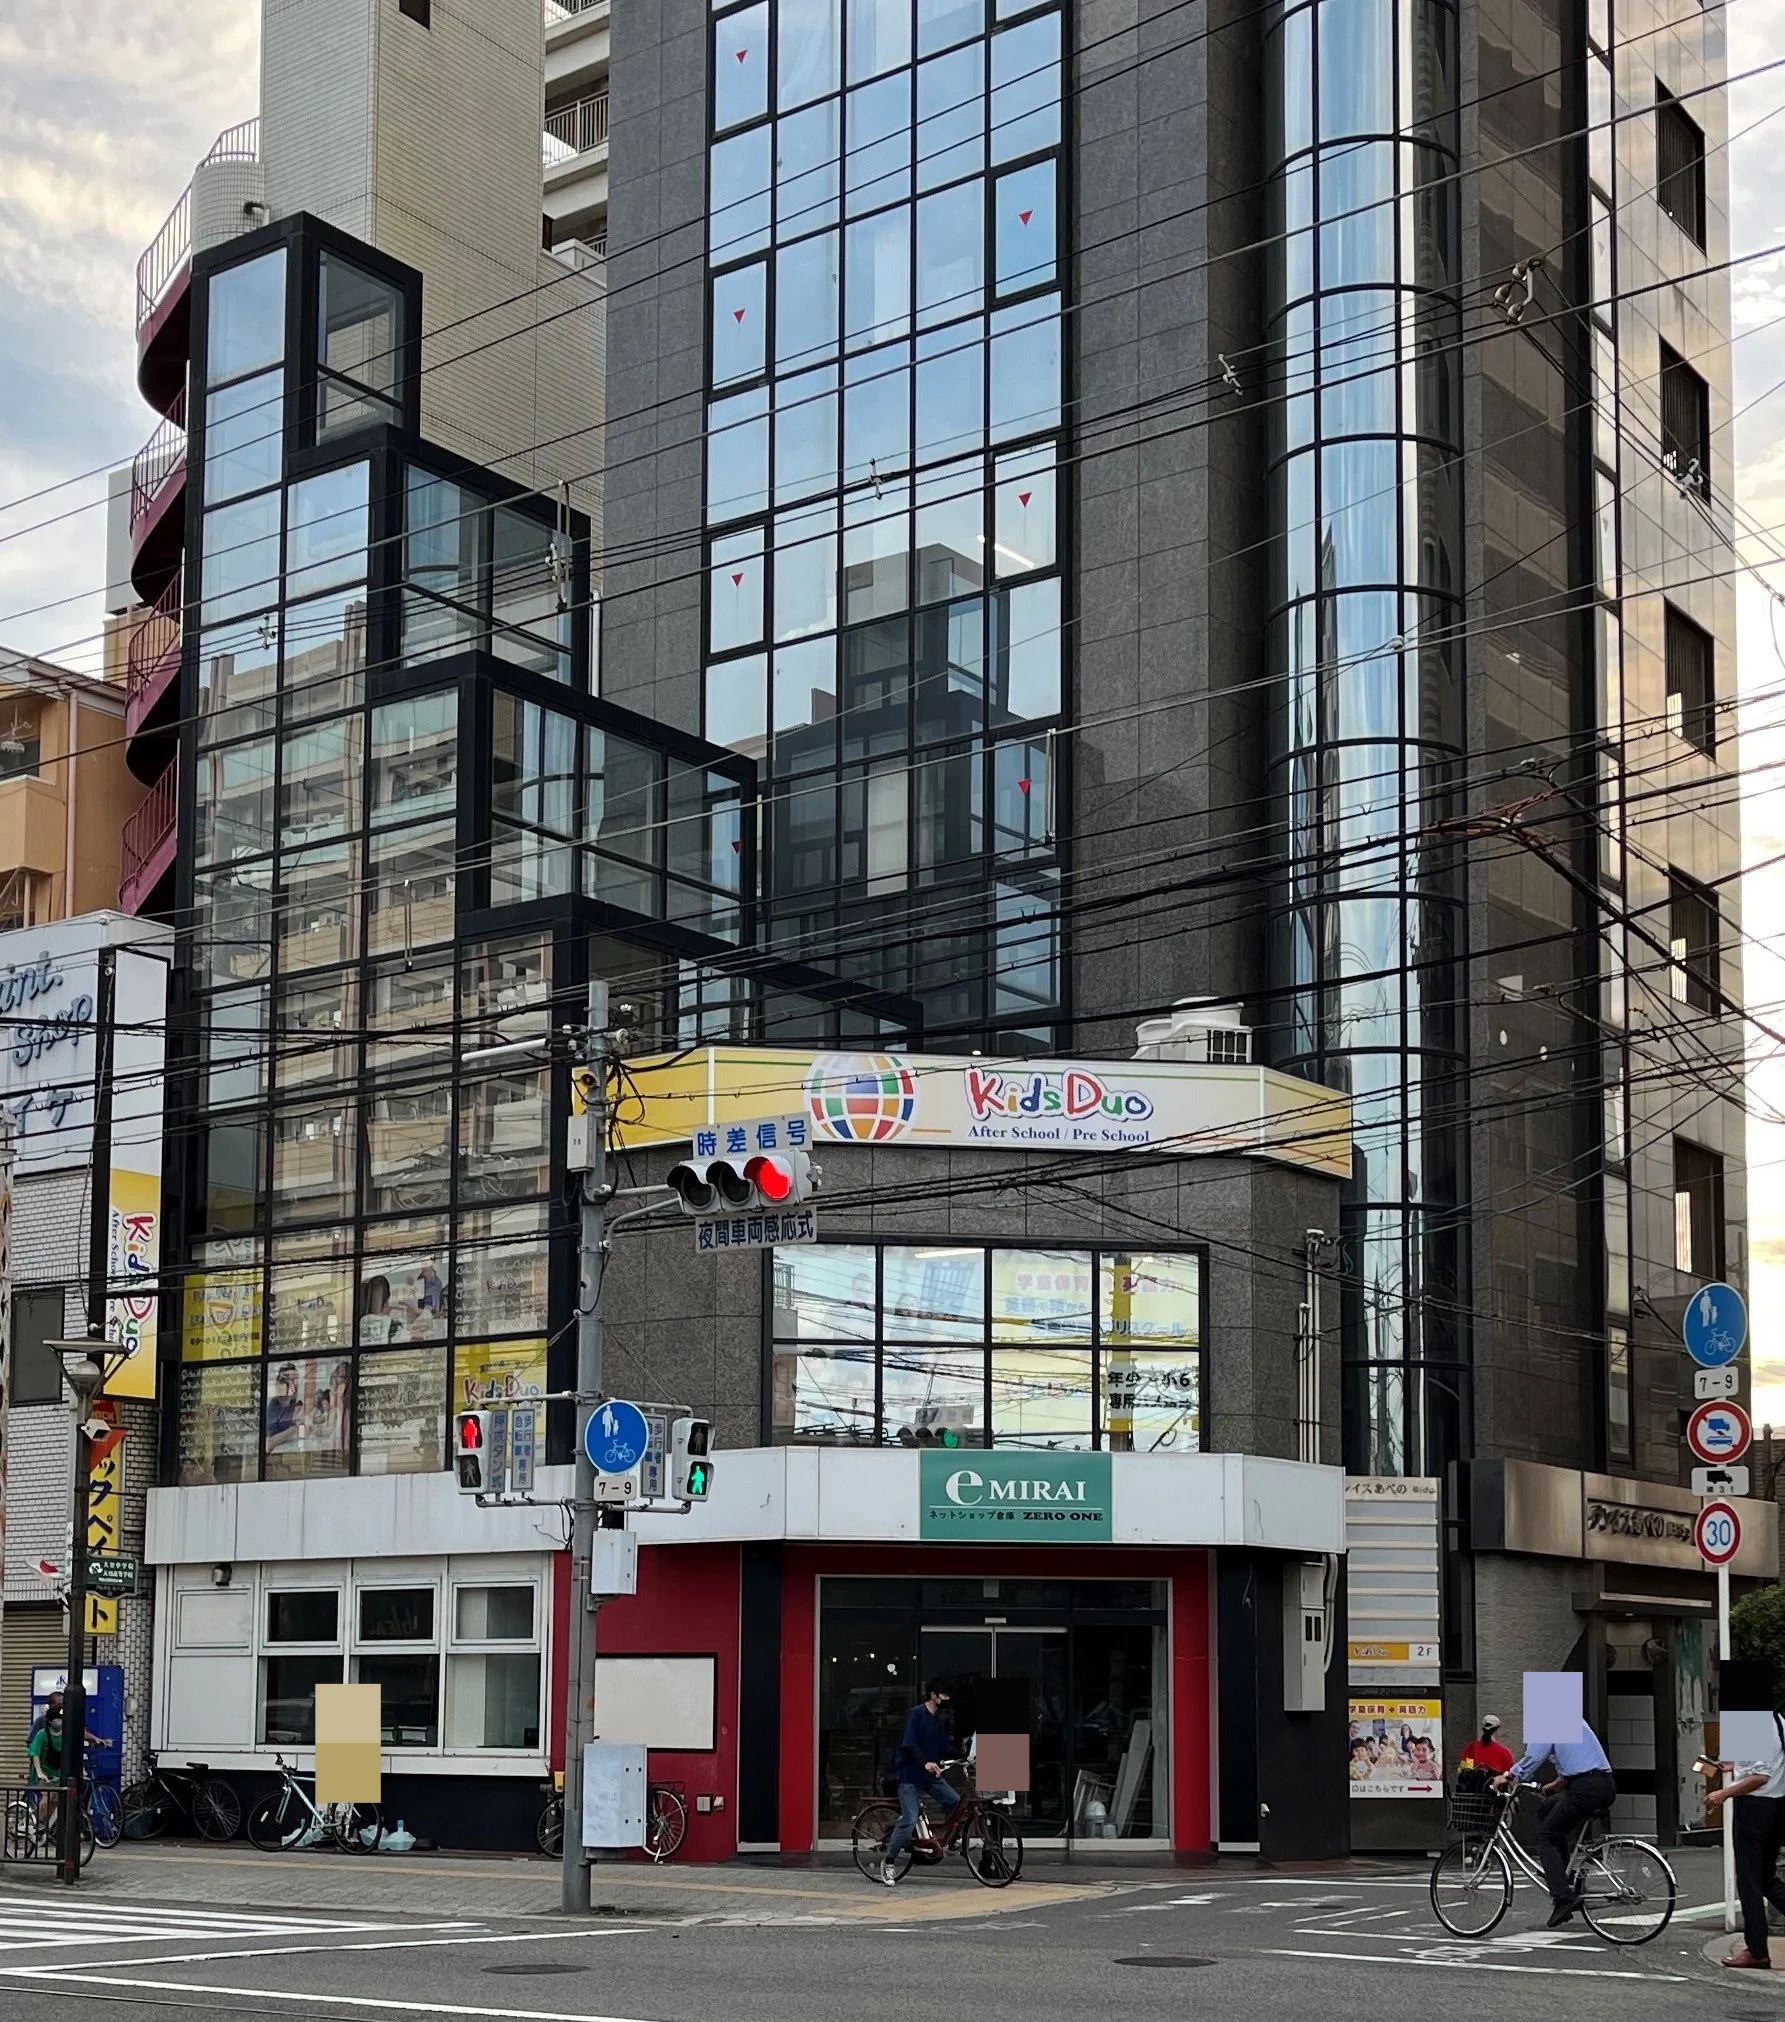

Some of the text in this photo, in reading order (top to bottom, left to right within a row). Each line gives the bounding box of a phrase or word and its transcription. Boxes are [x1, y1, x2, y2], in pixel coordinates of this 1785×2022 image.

[697, 1119, 807, 1156] 時差信号
[968, 1125, 1007, 1138] After
[1012, 1126, 1060, 1140] School
[1073, 1129, 1098, 1141] Pre
[1101, 1129, 1149, 1142] School
[698, 1209, 814, 1250] 夜間車両感応式
[124, 1214, 155, 1356] KidDuo
[929, 1511, 1103, 1521] ネットショップ倉庫 ZERO ONE
[1706, 1520, 1731, 1546] 30
